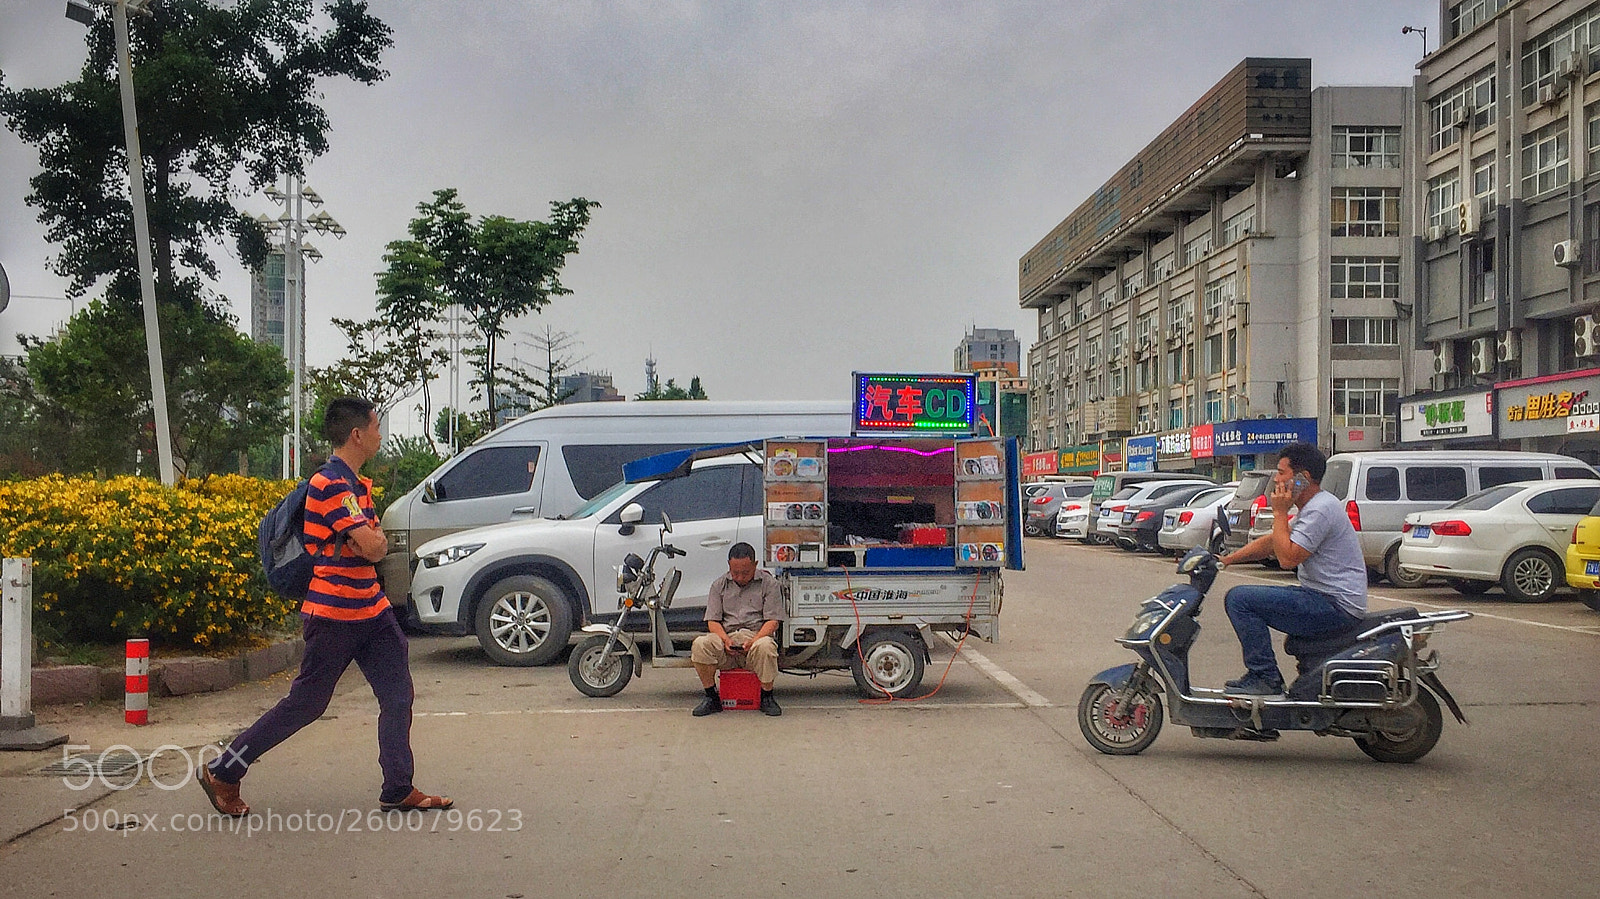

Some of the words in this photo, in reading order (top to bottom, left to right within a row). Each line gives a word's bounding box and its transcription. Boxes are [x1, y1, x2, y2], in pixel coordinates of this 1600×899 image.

[865, 385, 967, 421] 汽车CD
[856, 589, 908, 601] 中国淮海
